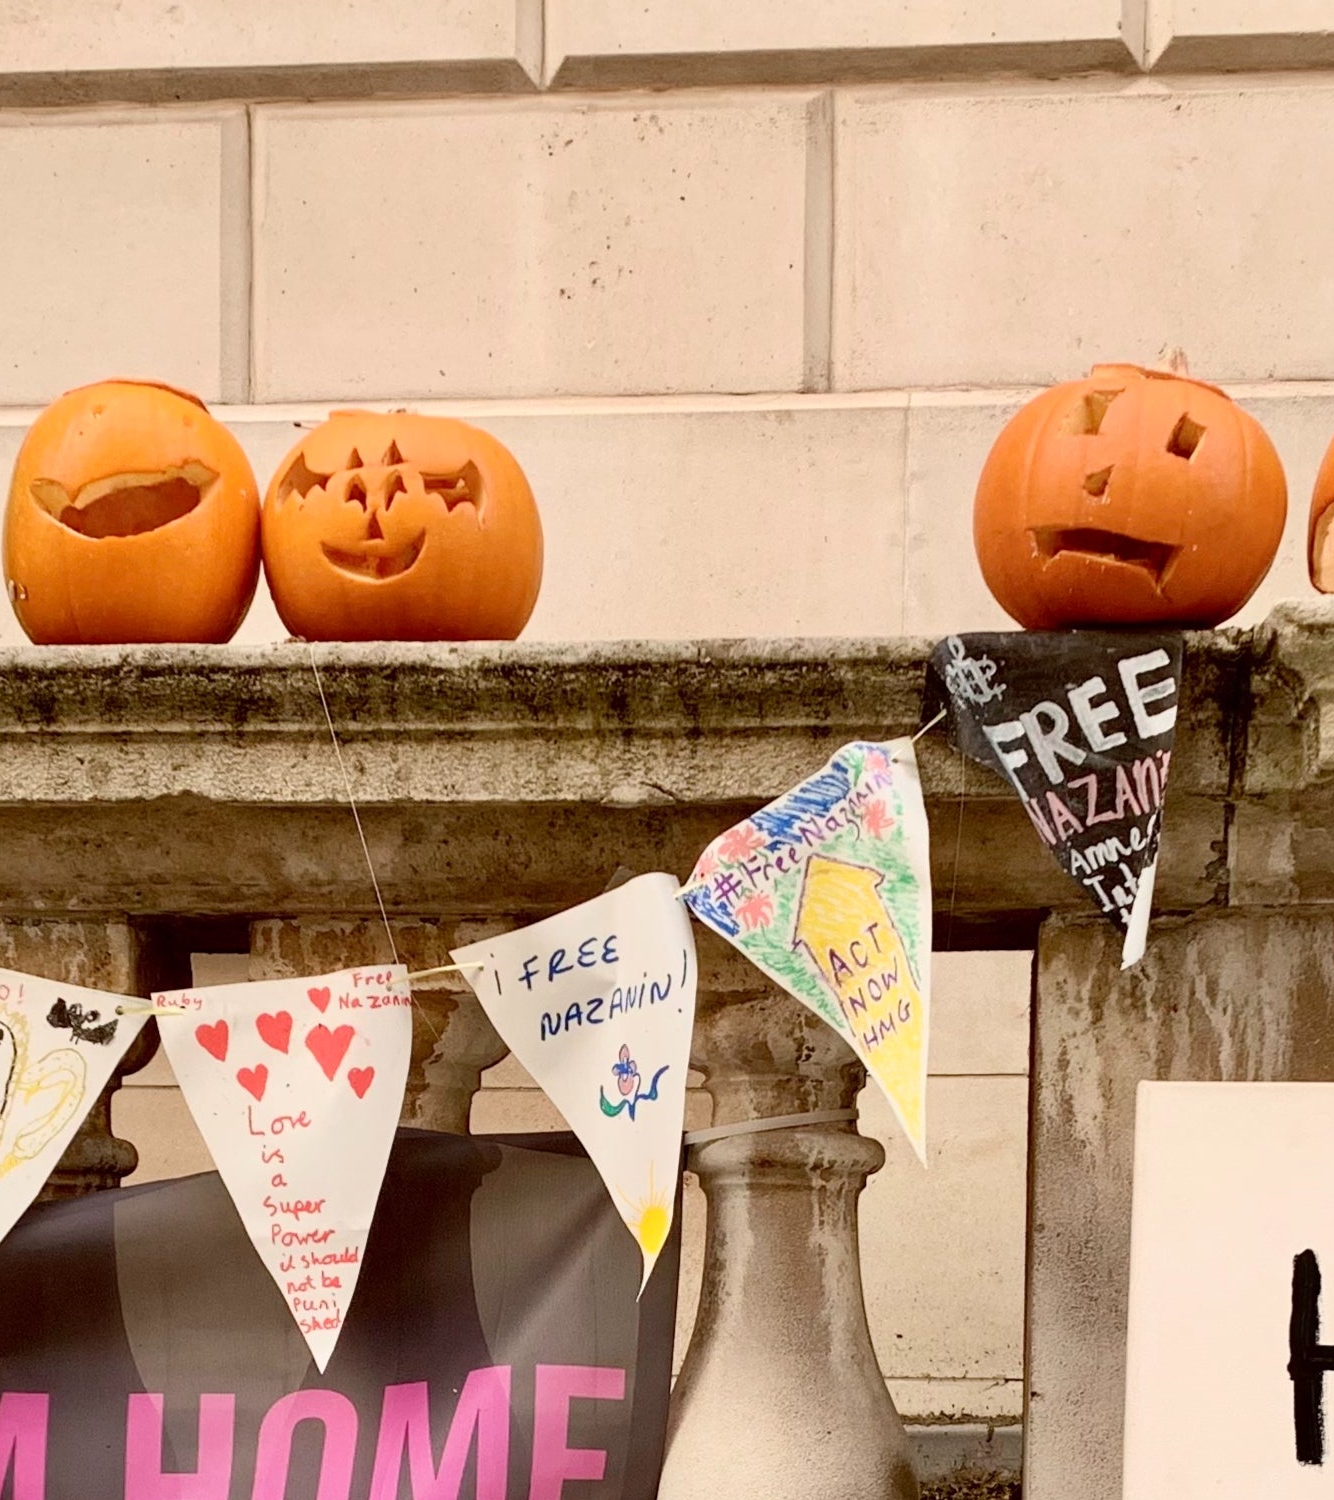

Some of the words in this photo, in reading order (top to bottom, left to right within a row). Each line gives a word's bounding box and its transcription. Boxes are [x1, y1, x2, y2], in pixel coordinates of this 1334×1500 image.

[982, 648, 1178, 800] FREE
[828, 921, 882, 988] ACT
[848, 956, 898, 1017] NOW
[156, 993, 203, 1011] Ruby
[248, 1105, 312, 1136] Love
[262, 1144, 285, 1164] is
[271, 1173, 288, 1188] a
[287, 1275, 316, 1294] not
